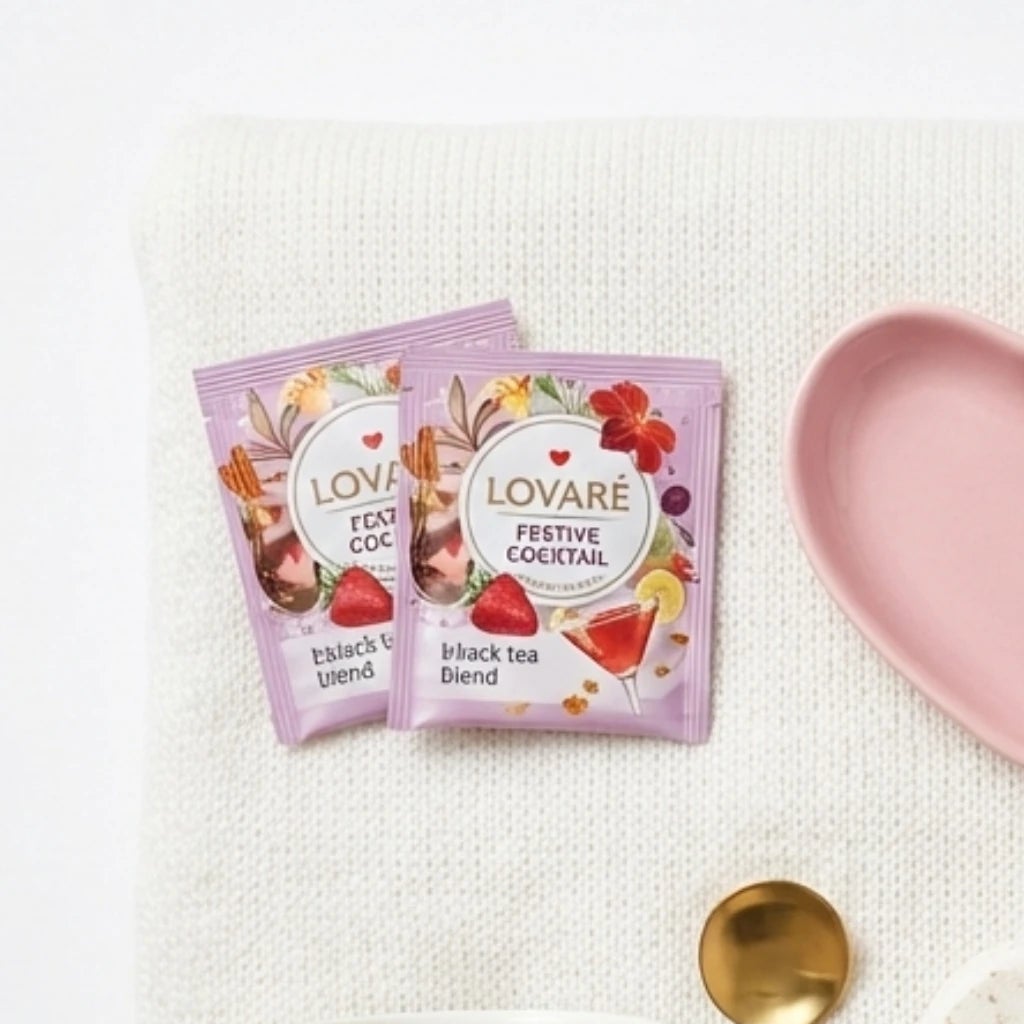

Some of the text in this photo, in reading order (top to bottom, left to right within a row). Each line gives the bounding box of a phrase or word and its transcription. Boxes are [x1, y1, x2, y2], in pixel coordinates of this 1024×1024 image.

[310, 461, 398, 505] LOVA
[487, 474, 630, 511] LOVARÉ
[350, 532, 392, 554] COC
[517, 524, 600, 545] FESTIVE
[507, 645, 538, 663] tea
